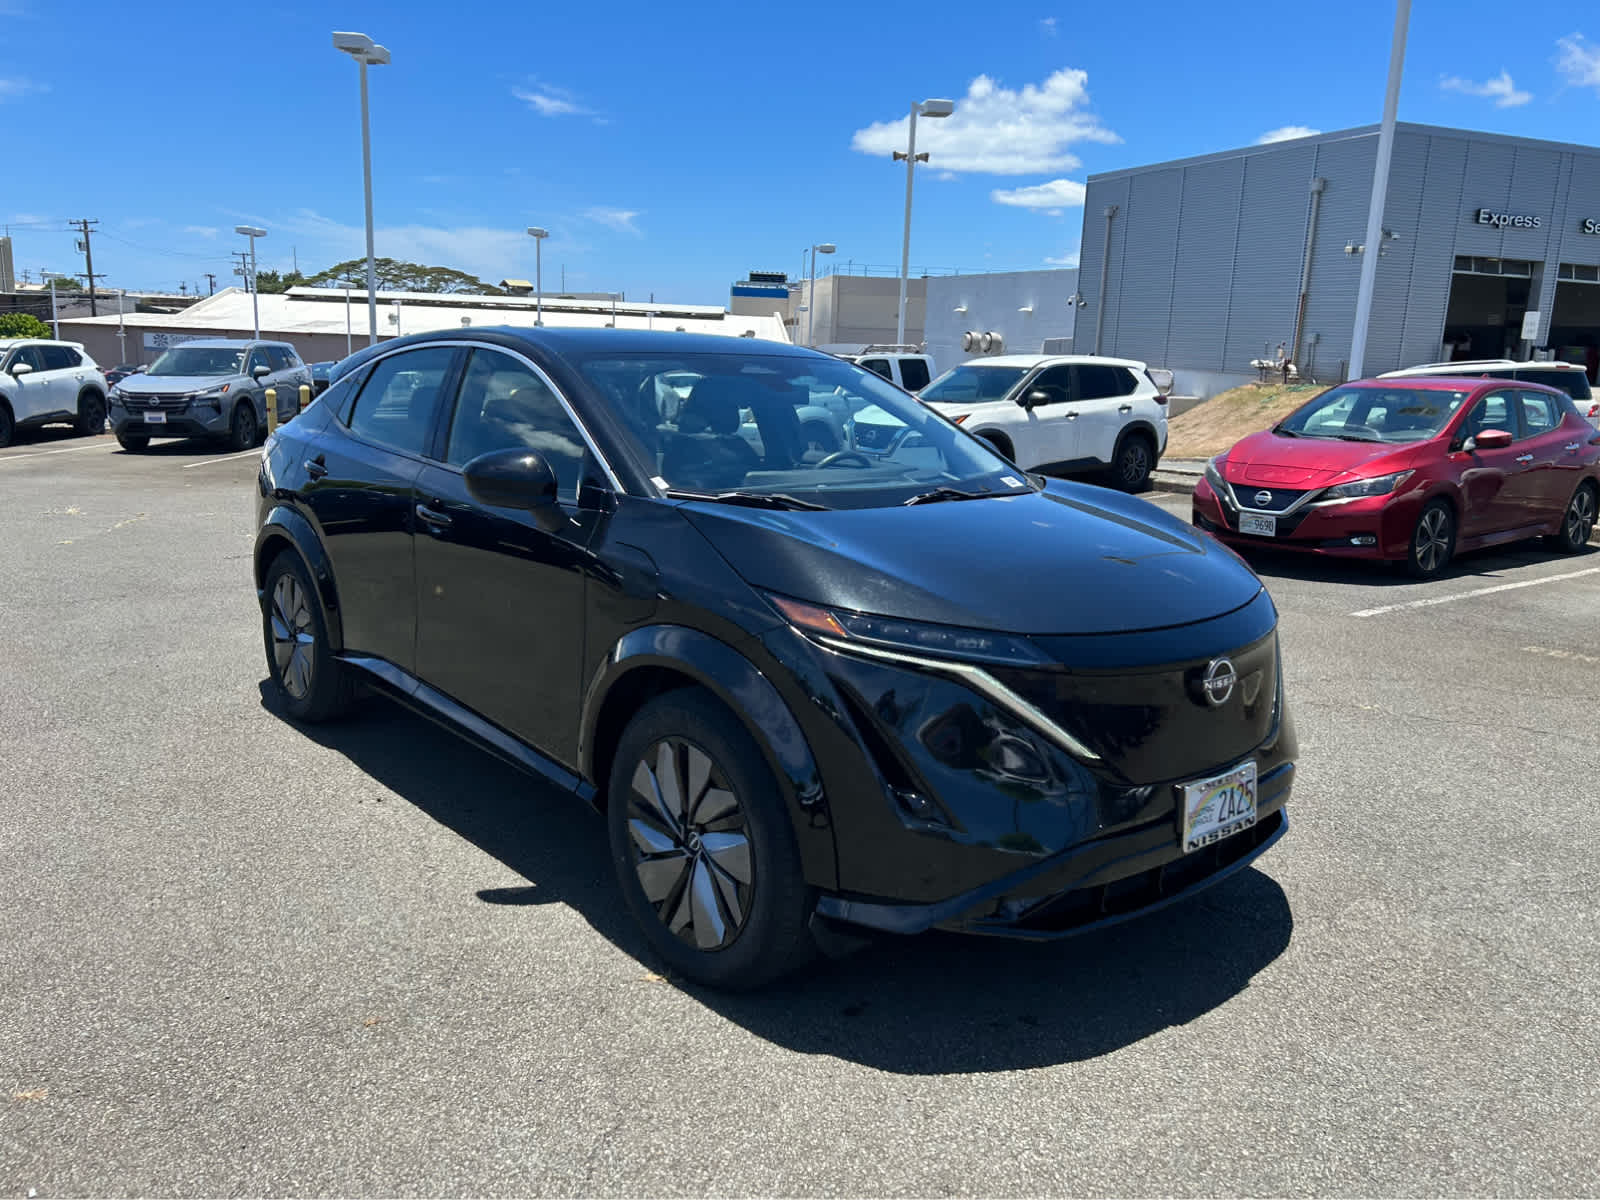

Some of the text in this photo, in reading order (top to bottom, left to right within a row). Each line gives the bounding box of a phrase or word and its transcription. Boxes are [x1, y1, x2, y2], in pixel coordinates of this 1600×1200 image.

[1479, 208, 1541, 229] Express
[1218, 779, 1254, 823] 2A25
[1187, 815, 1256, 850] NISSAN
